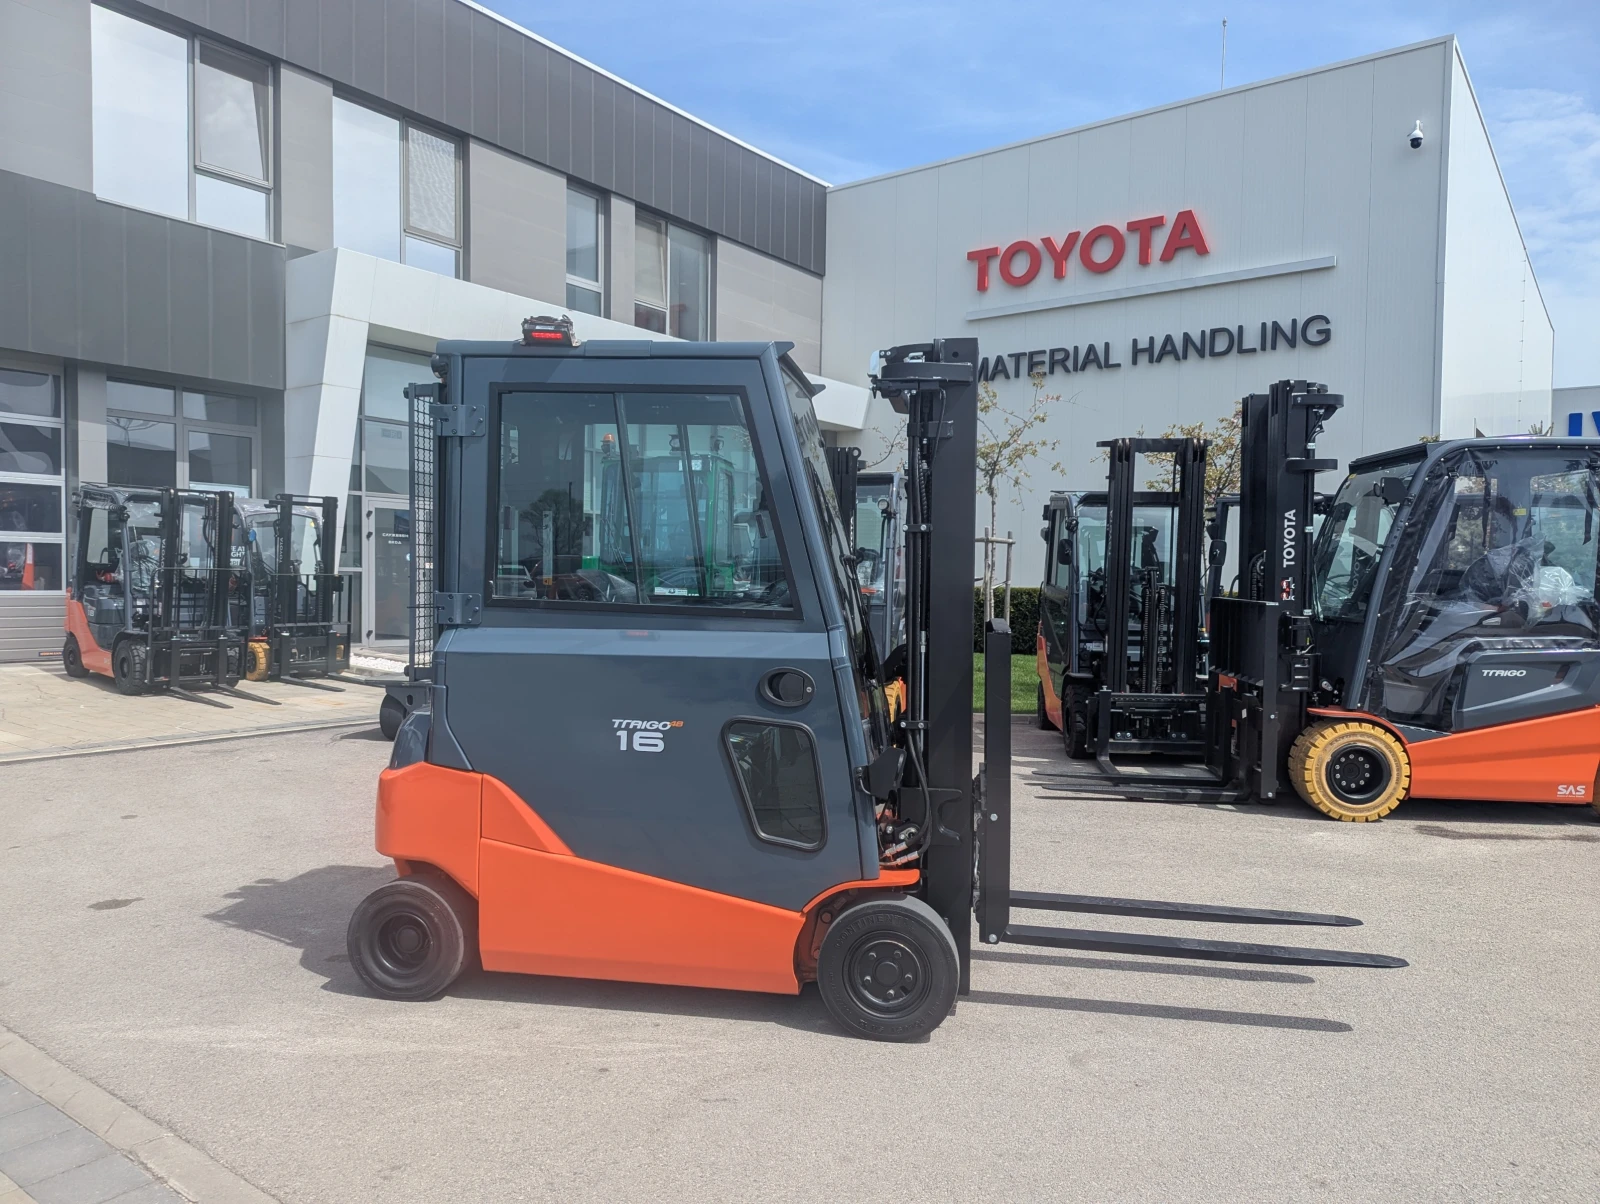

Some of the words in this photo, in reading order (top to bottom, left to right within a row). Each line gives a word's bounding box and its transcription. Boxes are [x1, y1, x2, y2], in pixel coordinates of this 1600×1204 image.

[967, 209, 1210, 292] TOYOTA
[1131, 314, 1332, 366] HANDLING
[1283, 509, 1296, 568] TOYOTA
[616, 730, 665, 752] 16
[1557, 784, 1586, 795] SAS
